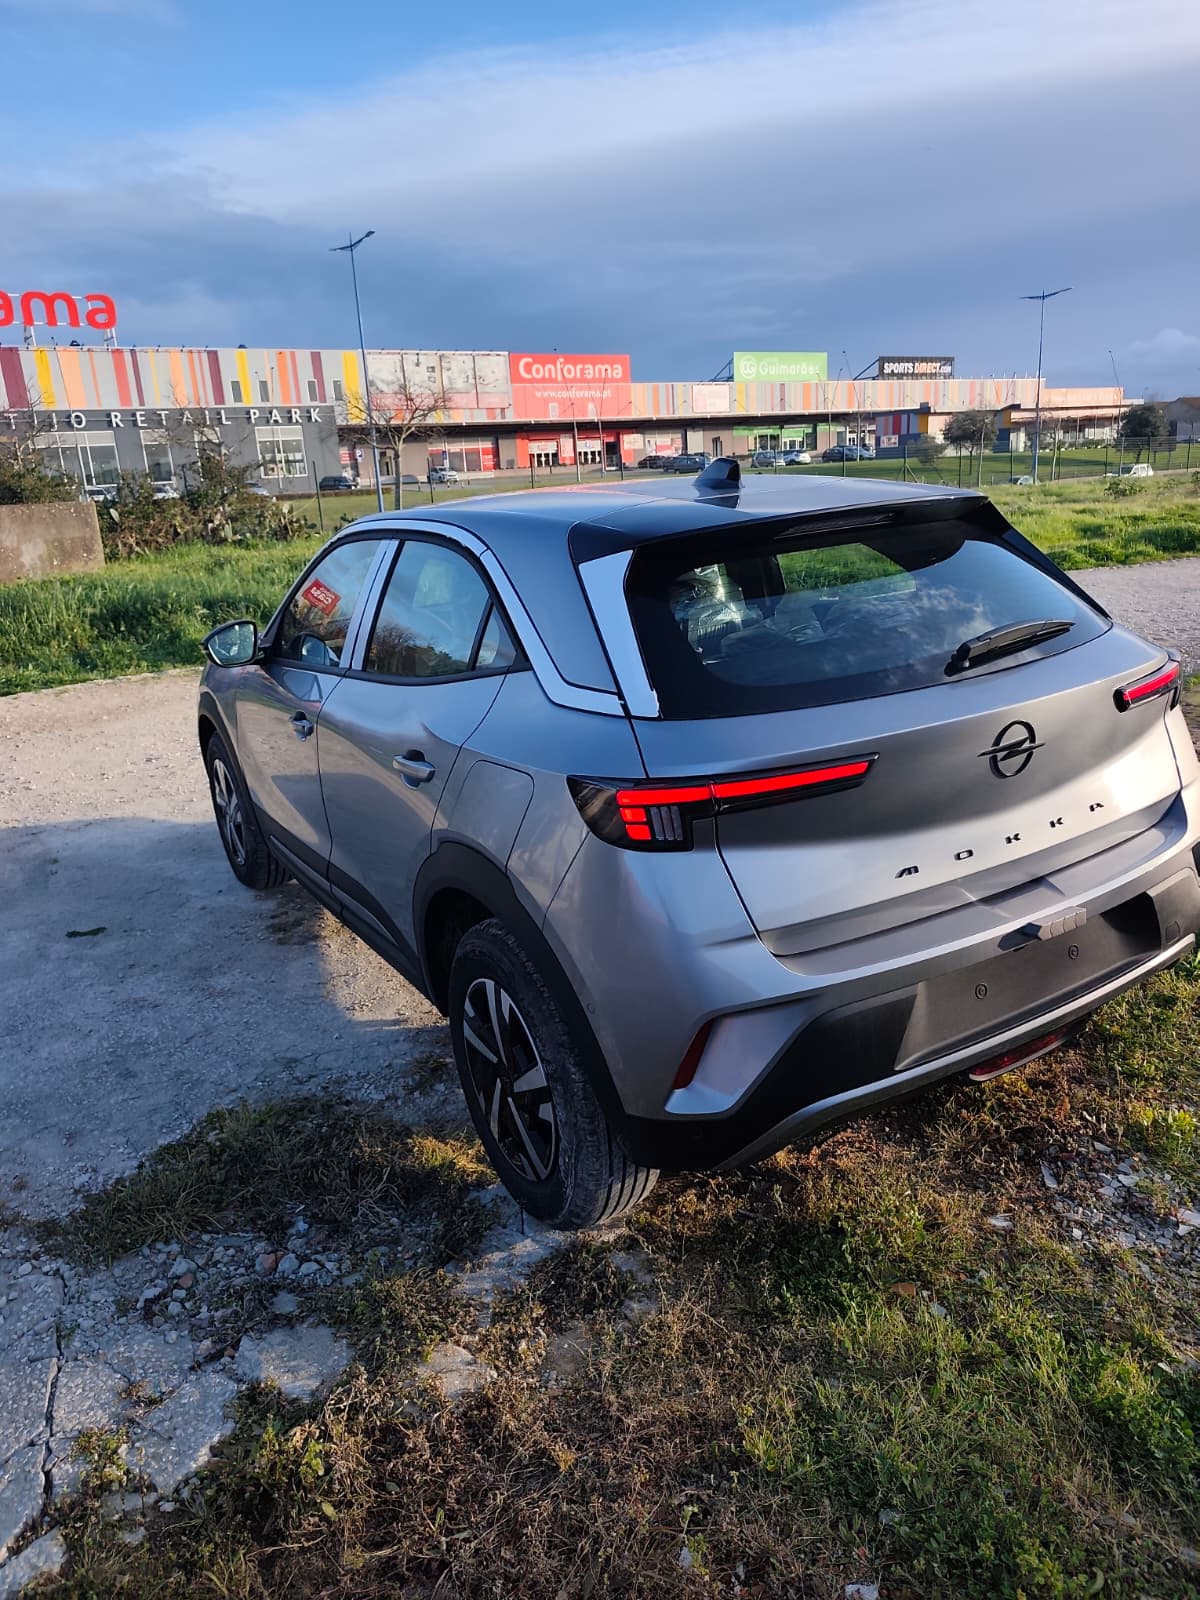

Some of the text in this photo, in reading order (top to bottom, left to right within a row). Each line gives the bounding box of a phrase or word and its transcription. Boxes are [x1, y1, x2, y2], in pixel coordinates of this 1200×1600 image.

[518, 357, 622, 381] Conforama
[883, 362, 914, 374] SPORTS
[535, 388, 611, 399] www.conforama.pt
[111, 409, 231, 428] RETAIL
[250, 408, 322, 423] PARK
[895, 802, 1104, 878] MOKKA
